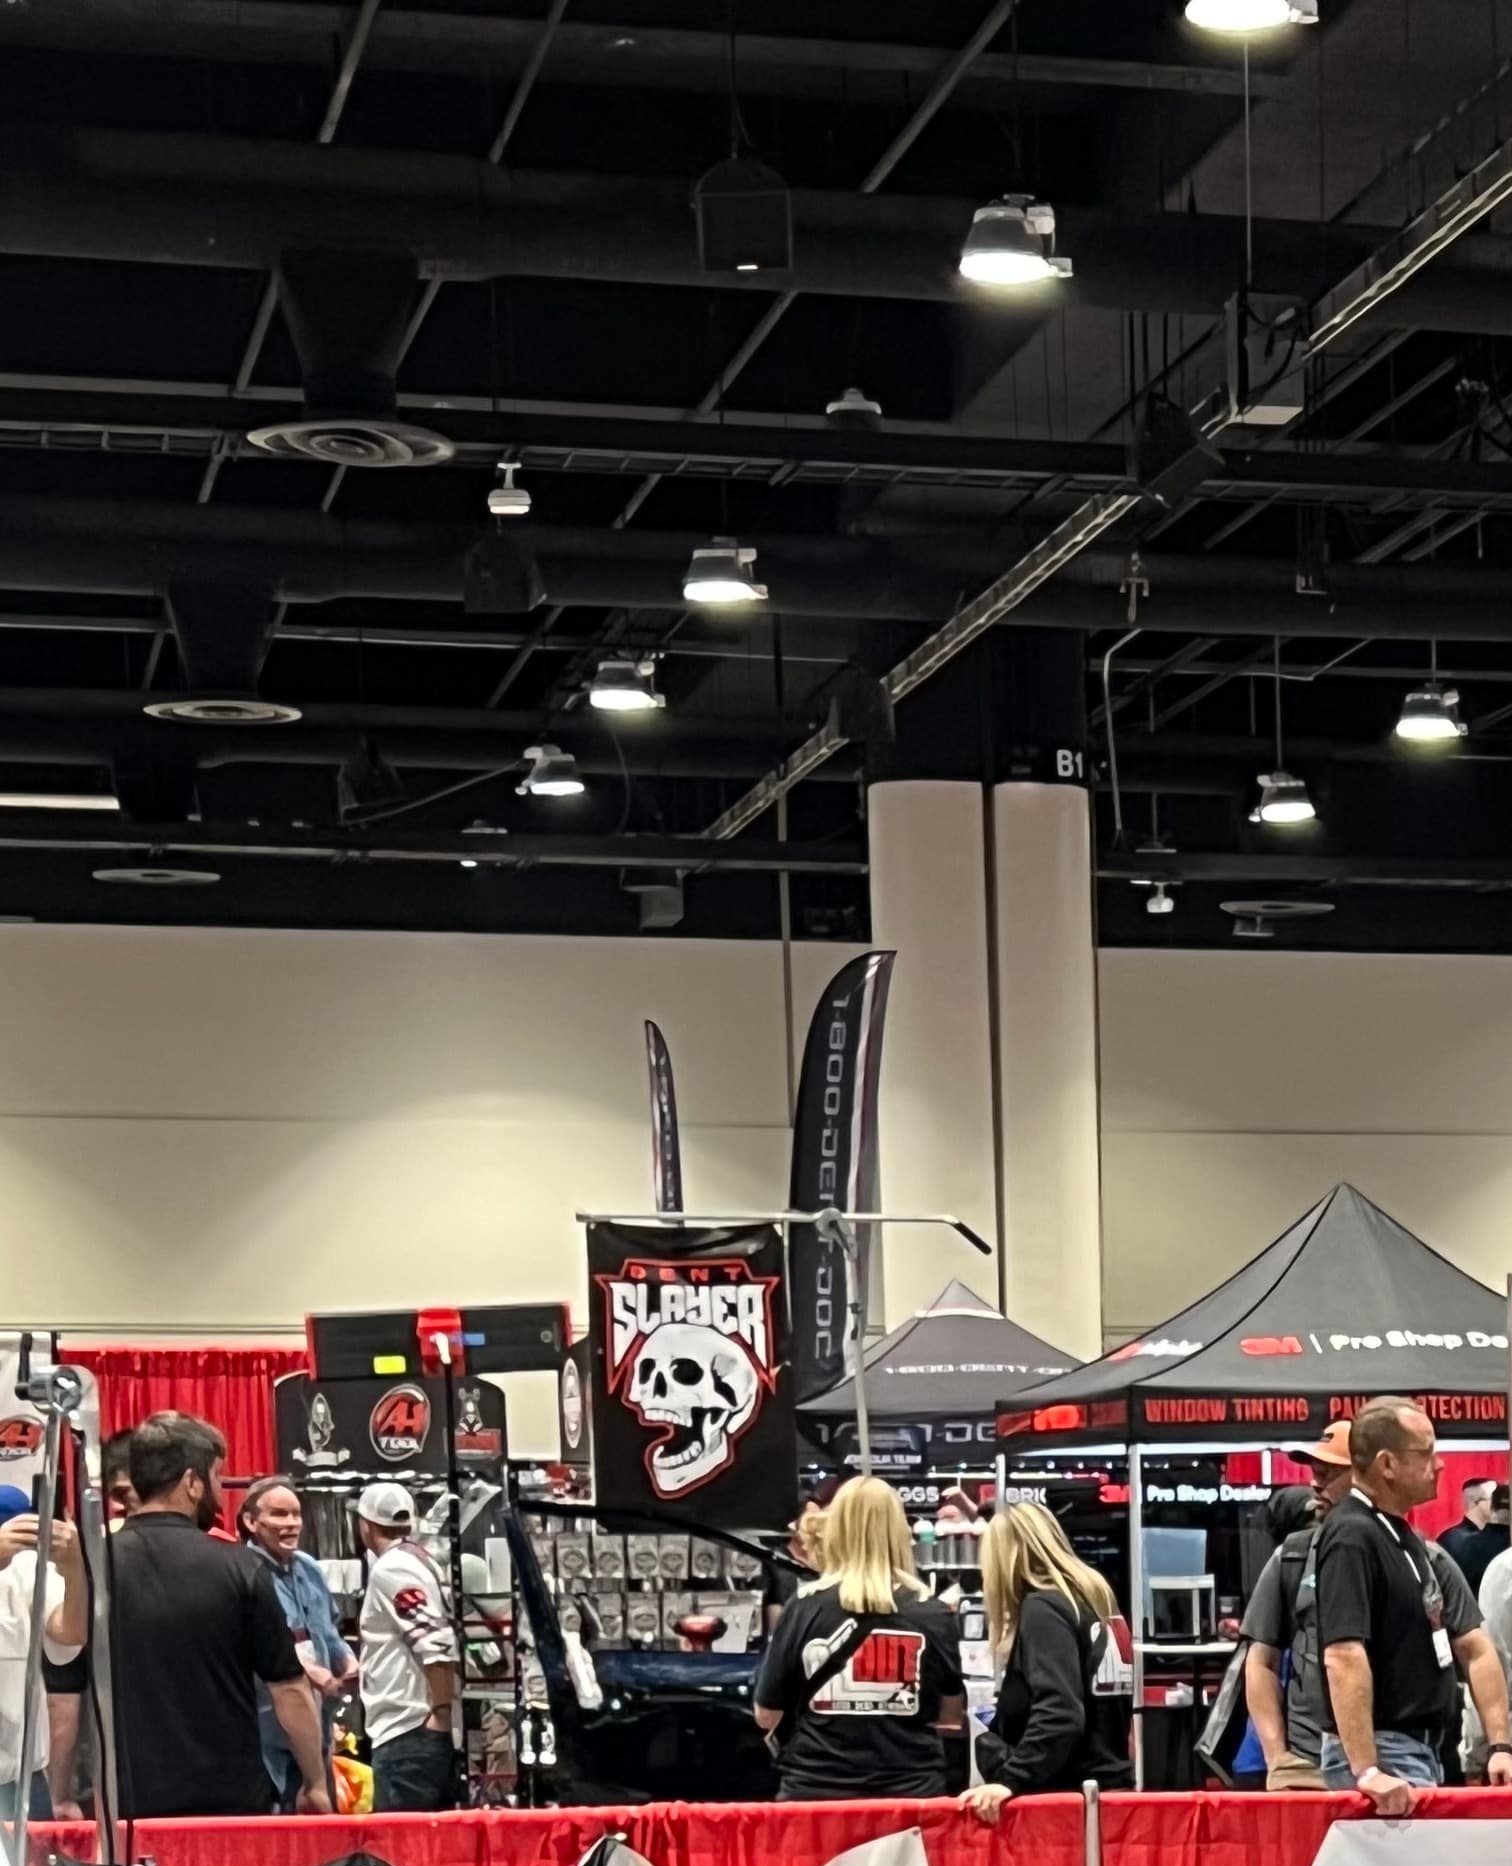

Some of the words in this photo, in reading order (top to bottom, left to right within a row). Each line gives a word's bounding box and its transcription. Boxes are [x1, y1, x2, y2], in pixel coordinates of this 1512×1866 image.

[1056, 749, 1083, 779] B1
[609, 1282, 768, 1369] SLAYER
[1330, 1334, 1383, 1350] Pro
[1385, 1329, 1463, 1350] Shop
[1144, 1398, 1227, 1422] WINDOW
[1232, 1397, 1310, 1421] TINTING
